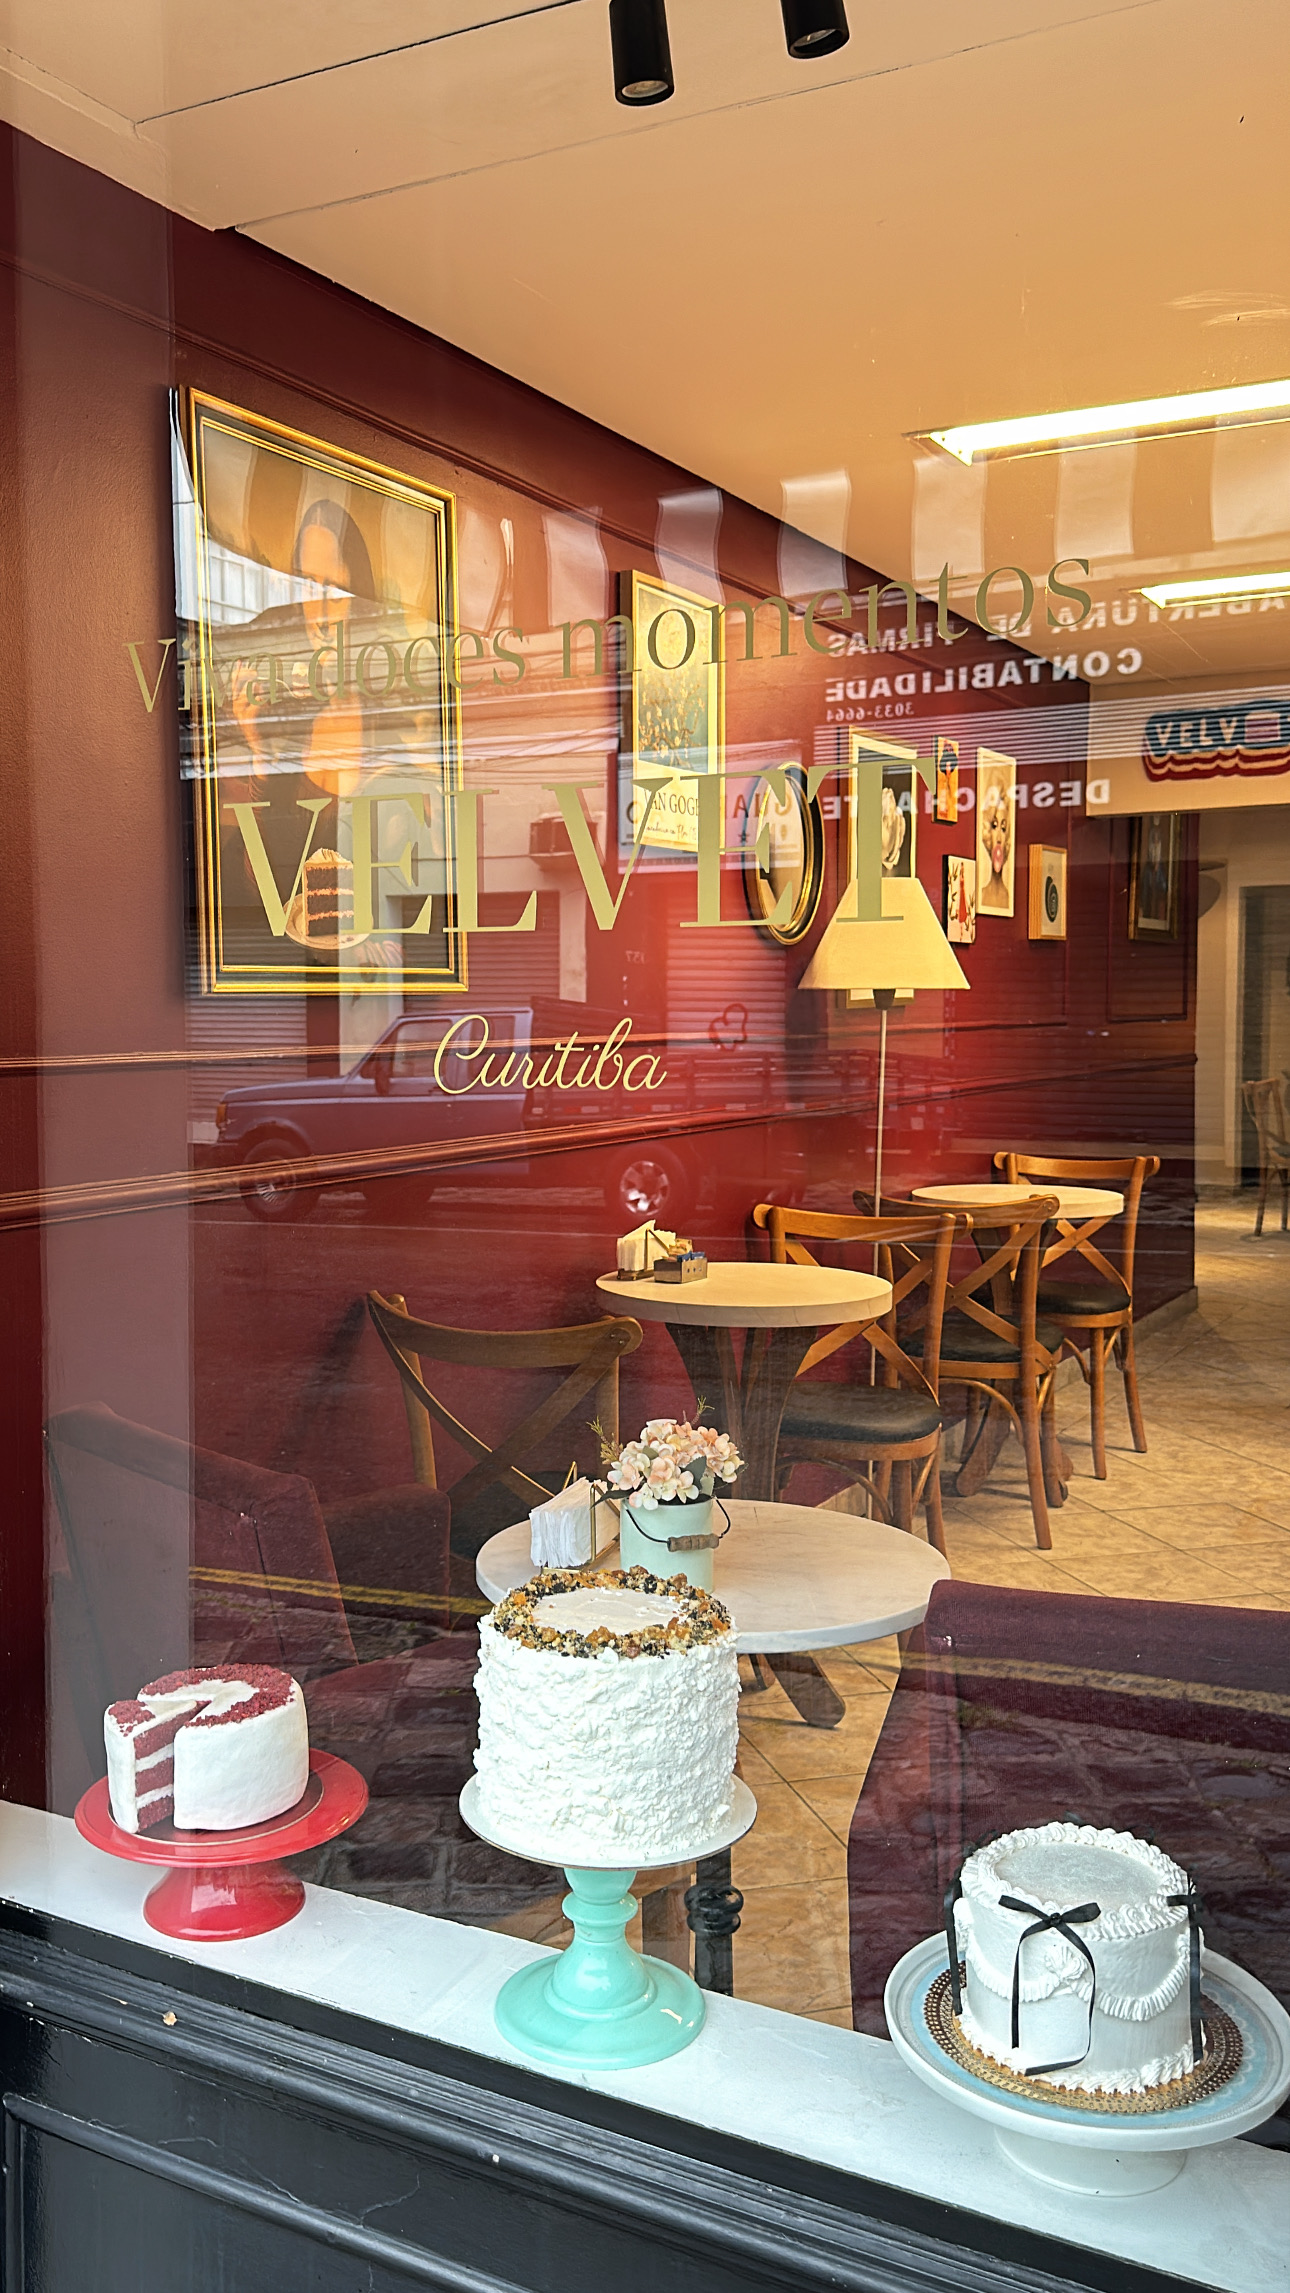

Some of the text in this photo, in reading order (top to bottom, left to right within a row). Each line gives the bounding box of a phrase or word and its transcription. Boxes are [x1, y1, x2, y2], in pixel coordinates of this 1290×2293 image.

[122, 558, 1092, 713] Viva doces momentos
[223, 757, 936, 937] VELVET
[433, 1015, 667, 1094] Curitiba
